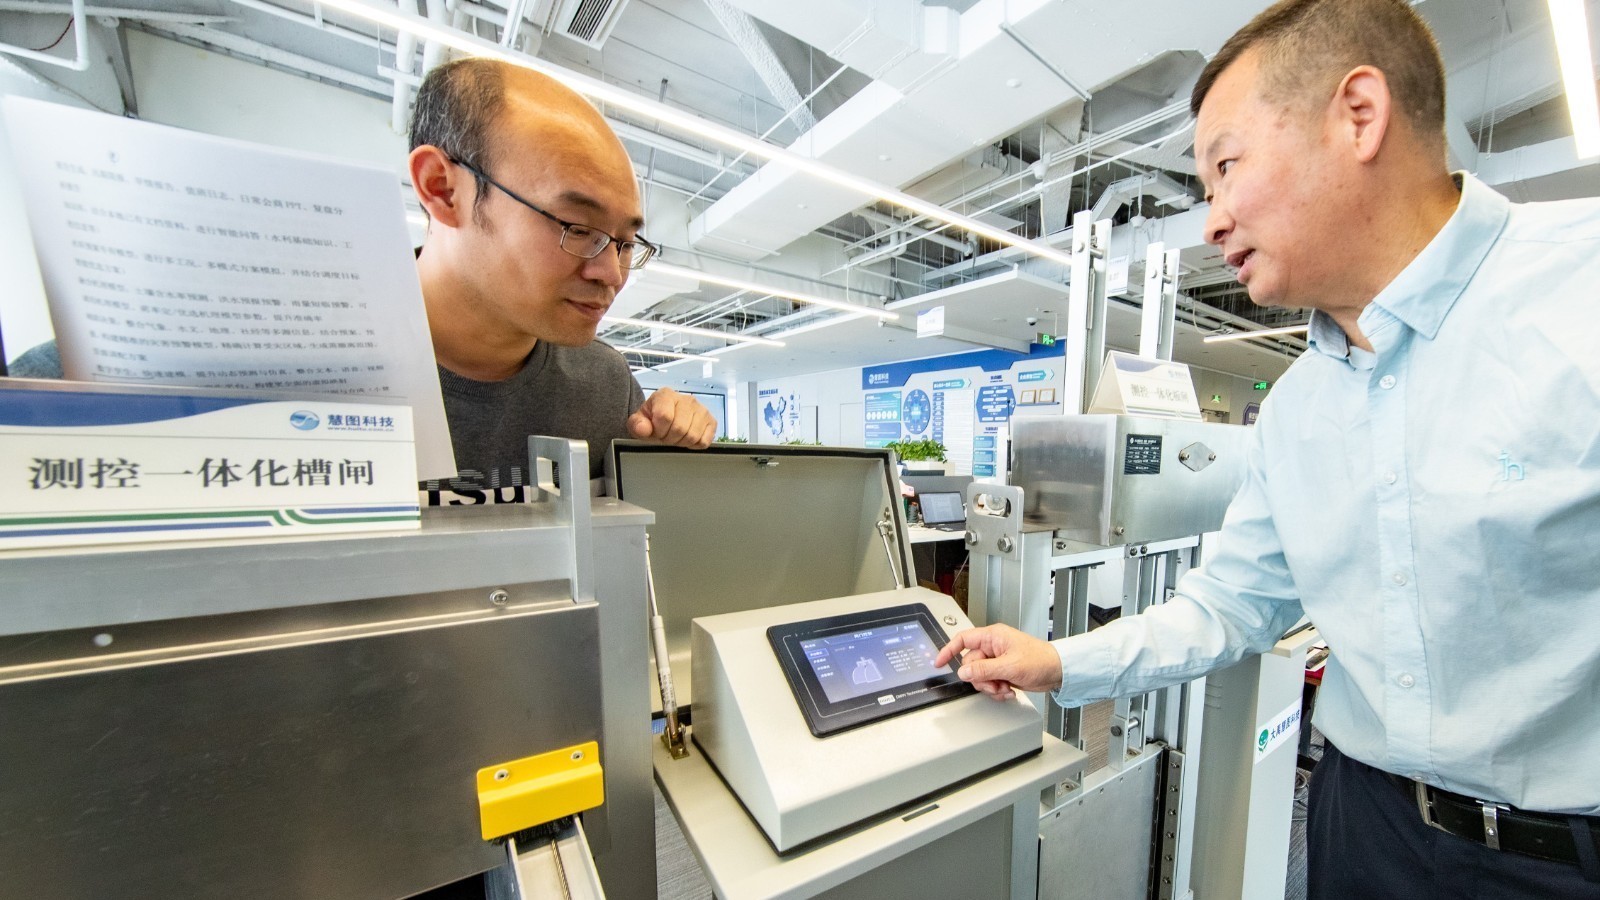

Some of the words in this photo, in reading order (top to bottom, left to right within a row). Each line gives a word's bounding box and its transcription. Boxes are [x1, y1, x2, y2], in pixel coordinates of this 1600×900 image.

[327, 414, 395, 427] 慧图科技
[28, 456, 375, 490] 测控一体化槽闸
